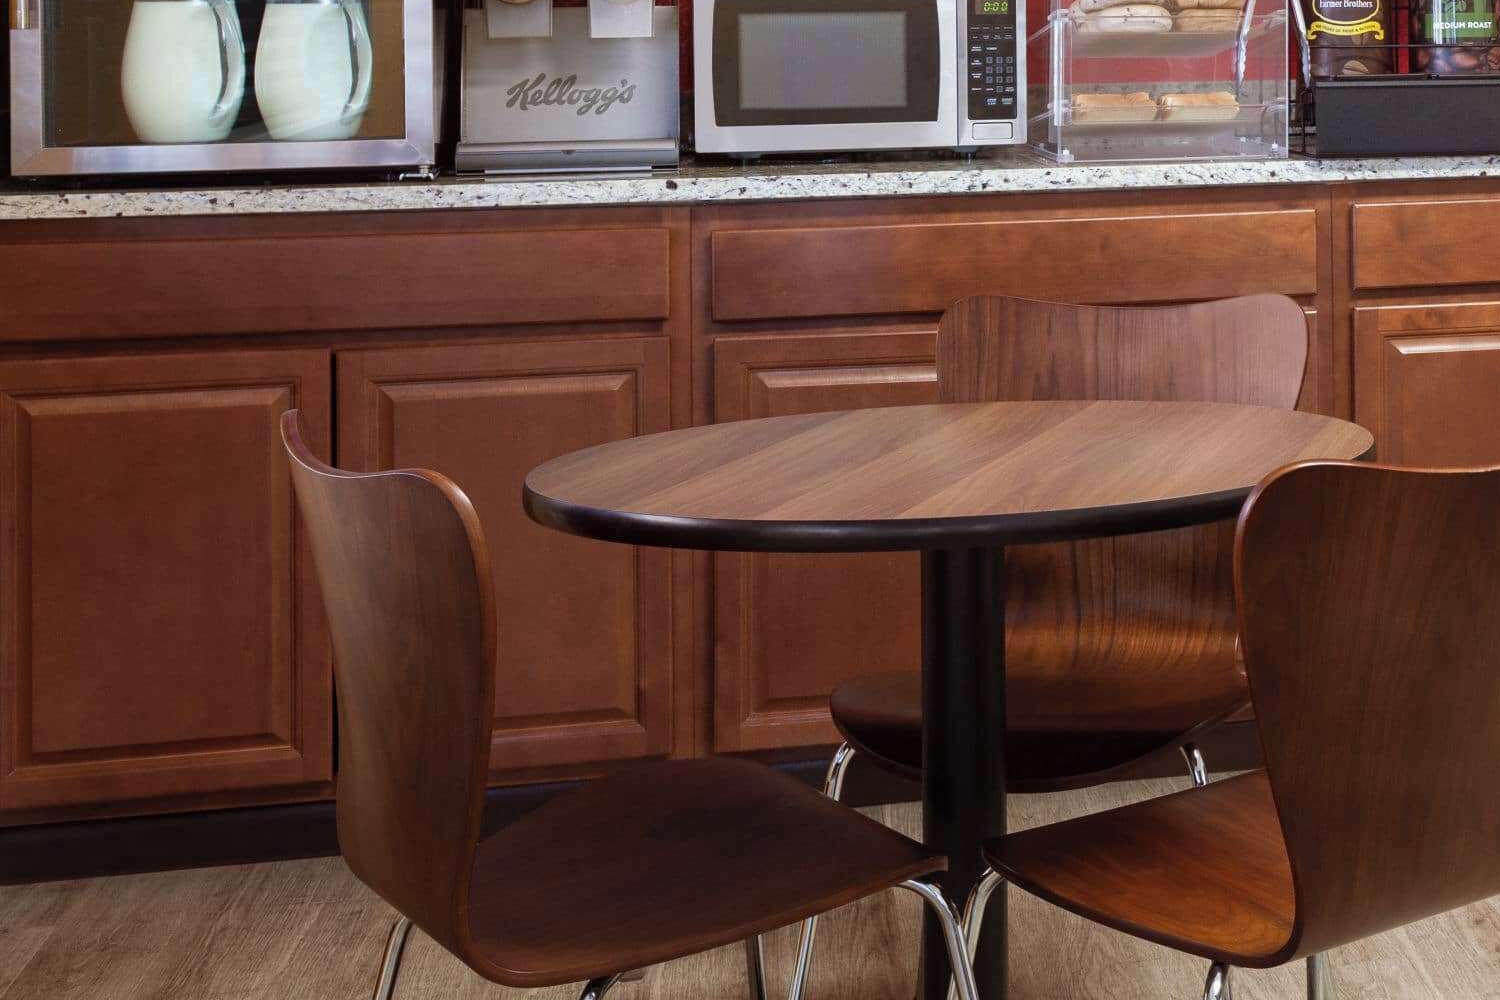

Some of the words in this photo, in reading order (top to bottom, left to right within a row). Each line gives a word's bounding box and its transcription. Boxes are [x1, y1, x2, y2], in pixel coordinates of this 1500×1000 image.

[1433, 21, 1466, 30] MEDIUM
[1467, 21, 1492, 29] ROAST
[505, 72, 637, 116] Kellogg's
